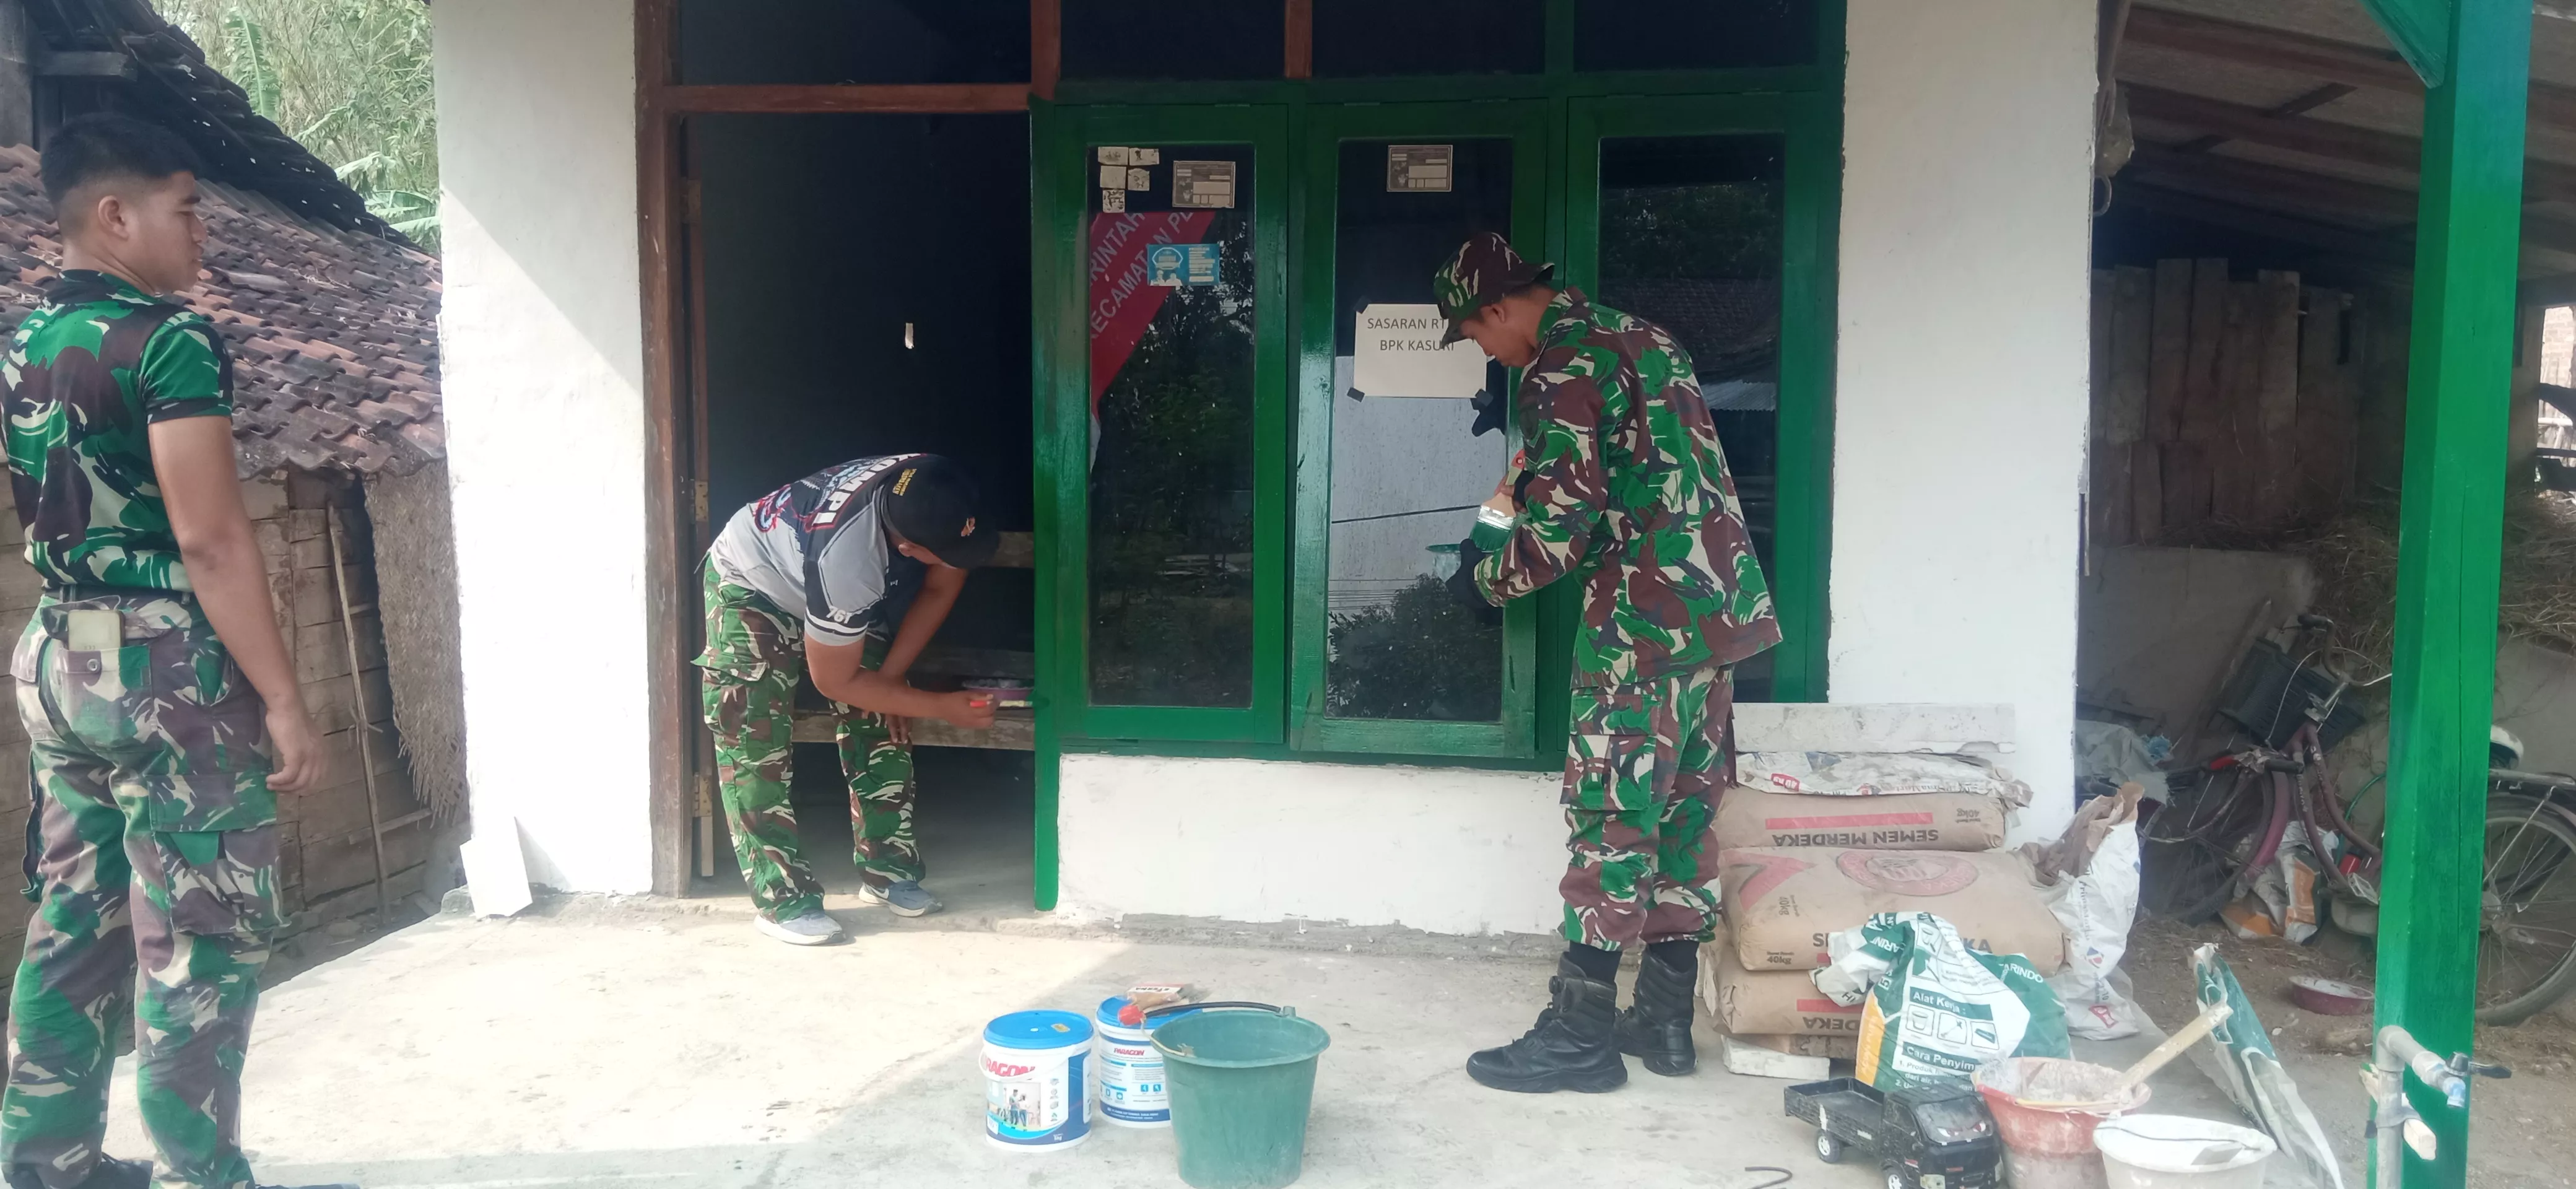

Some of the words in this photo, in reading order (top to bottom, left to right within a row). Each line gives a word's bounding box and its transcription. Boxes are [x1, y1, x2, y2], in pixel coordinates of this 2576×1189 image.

[1090, 212, 1146, 287] RINTAH
[1090, 227, 1173, 339] ECAMATN
[1367, 318, 1427, 329] SASARAN
[1380, 340, 1404, 351] BPK
[1772, 832, 1866, 847] MERDEKA
[1873, 829, 1939, 844] SEMEN
[1913, 991, 1934, 1004] Alat
[1113, 1047, 1145, 1056] PARAGON
[1907, 1045, 1931, 1061] Cara
[1907, 1061, 1934, 1074] Produk
